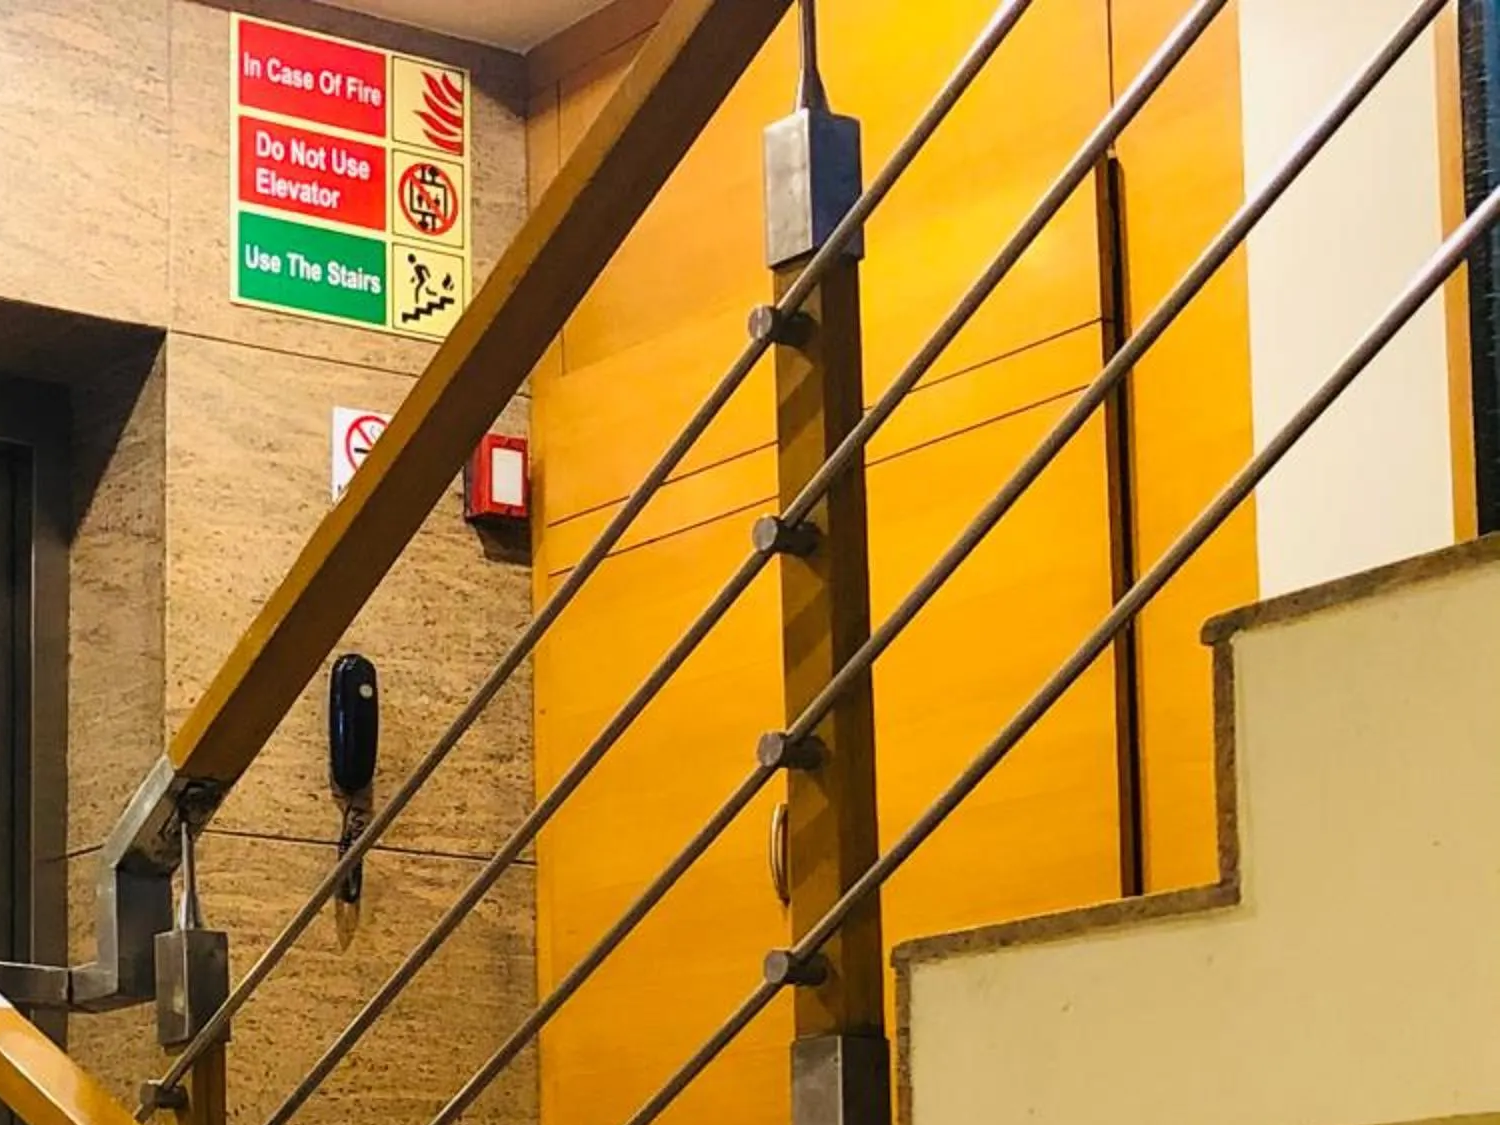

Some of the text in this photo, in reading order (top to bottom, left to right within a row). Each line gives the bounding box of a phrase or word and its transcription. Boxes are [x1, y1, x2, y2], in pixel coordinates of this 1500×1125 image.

[243, 52, 382, 107] In Case Of Fire
[255, 131, 371, 180] Do Not Use
[255, 168, 341, 209] Elevator
[245, 244, 382, 295] Use The Stairs
